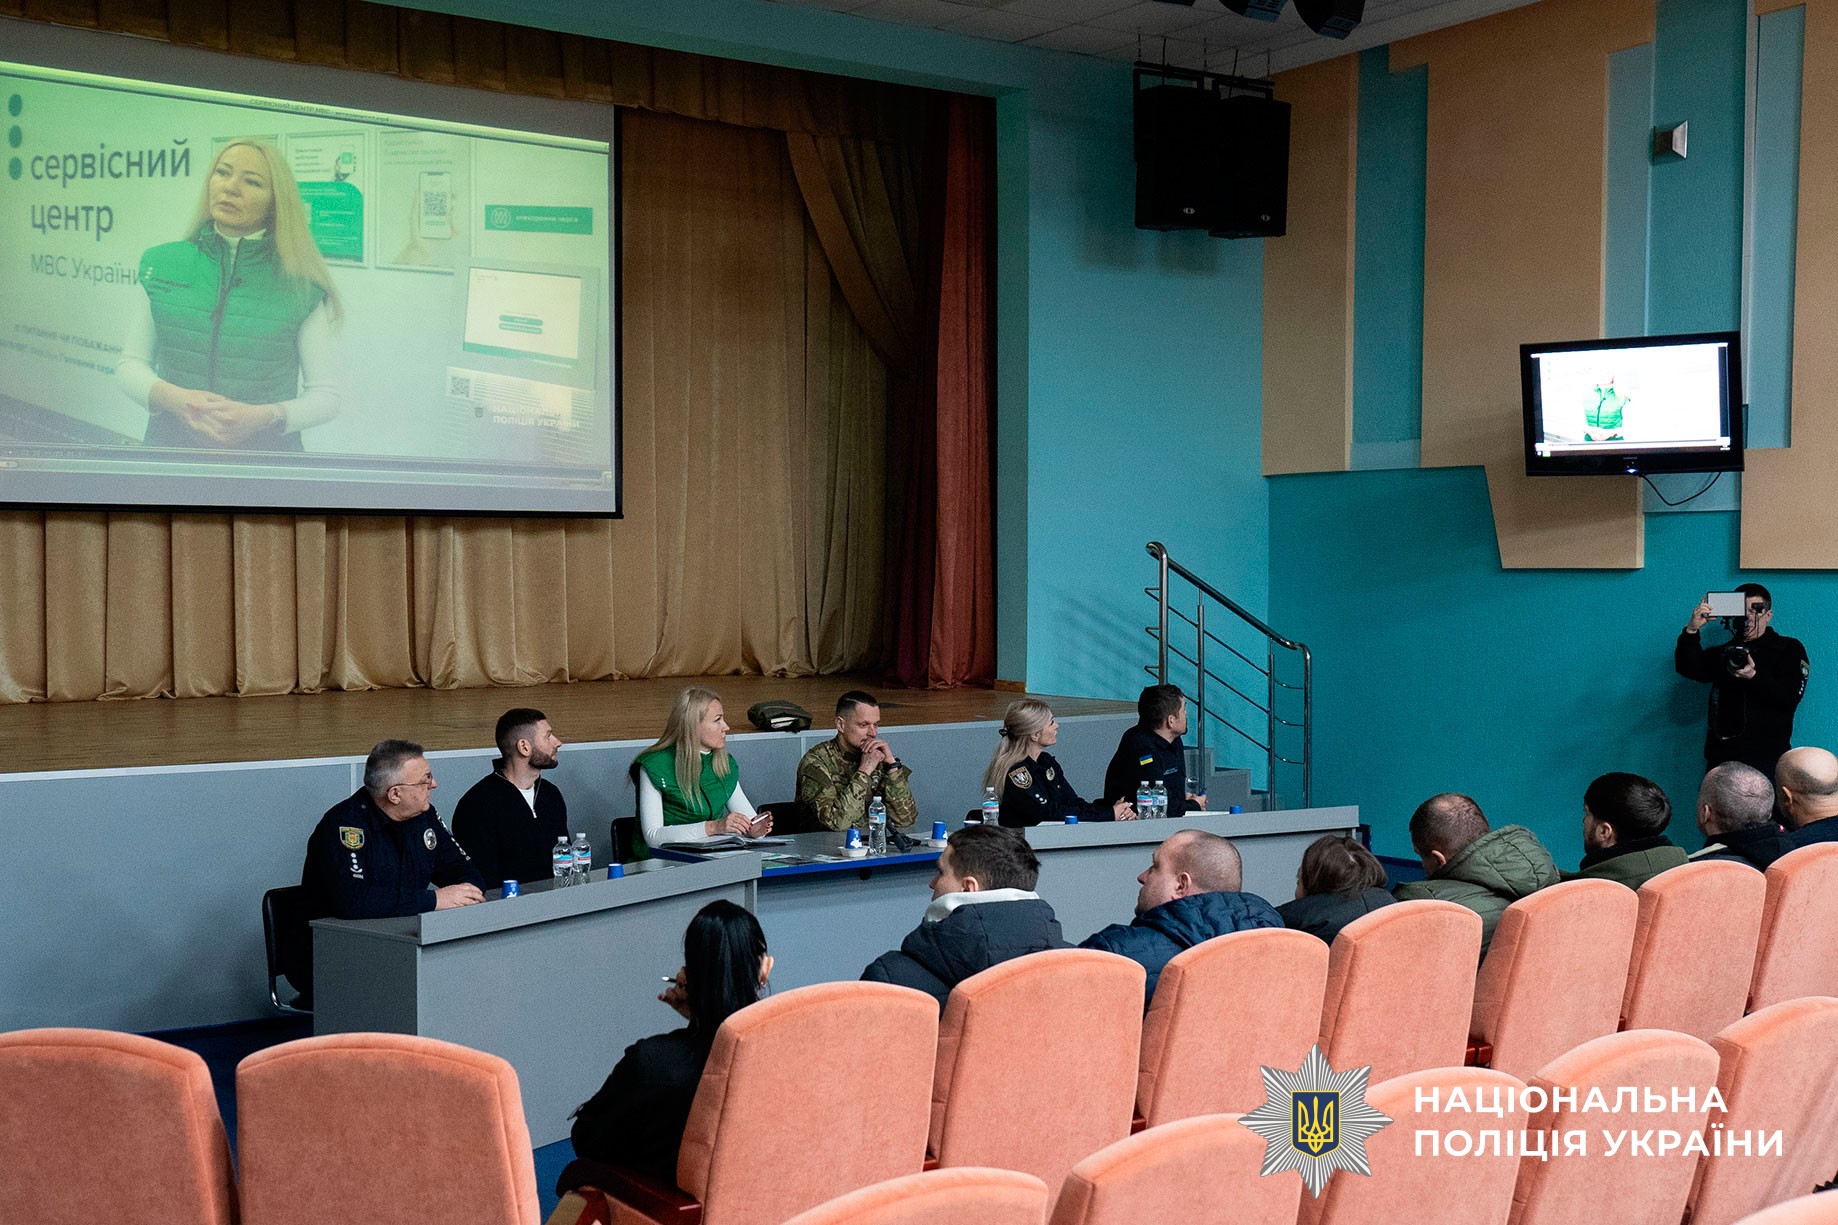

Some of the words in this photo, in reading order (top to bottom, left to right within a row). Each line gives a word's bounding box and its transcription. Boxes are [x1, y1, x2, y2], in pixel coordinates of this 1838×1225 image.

[30, 138, 191, 188] сервісний
[30, 203, 114, 241] центр
[31, 254, 67, 277] МВС
